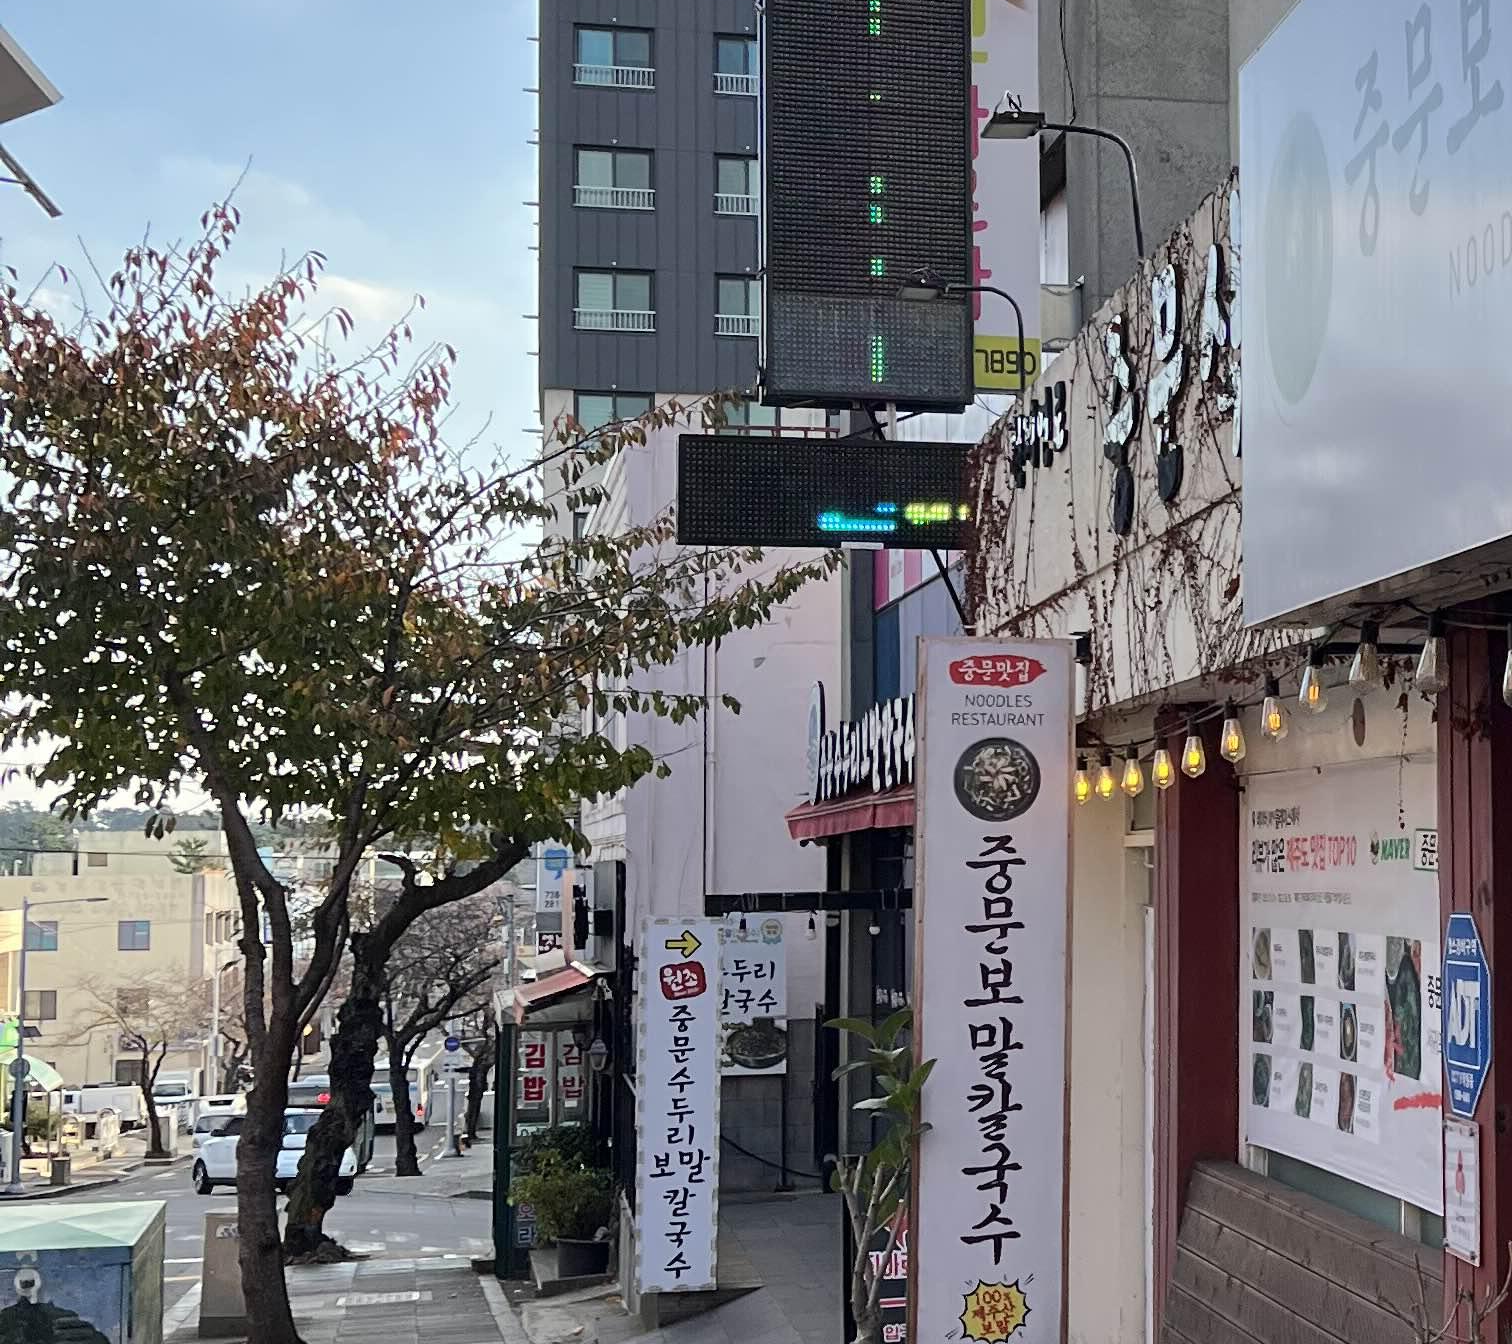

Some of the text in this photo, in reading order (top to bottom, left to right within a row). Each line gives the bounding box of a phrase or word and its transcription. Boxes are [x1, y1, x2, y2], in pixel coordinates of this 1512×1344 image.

[958, 659, 1030, 682] 중문맛집
[965, 694, 1033, 708] NOODLES
[952, 712, 1045, 727] RESTAURANT
[1328, 835, 1358, 867] TOP10
[1380, 837, 1411, 861] NAVER
[1448, 979, 1481, 1049] ADT
[959, 834, 1026, 1266] 중문보말칼국수
[523, 1043, 547, 1101] 김밥
